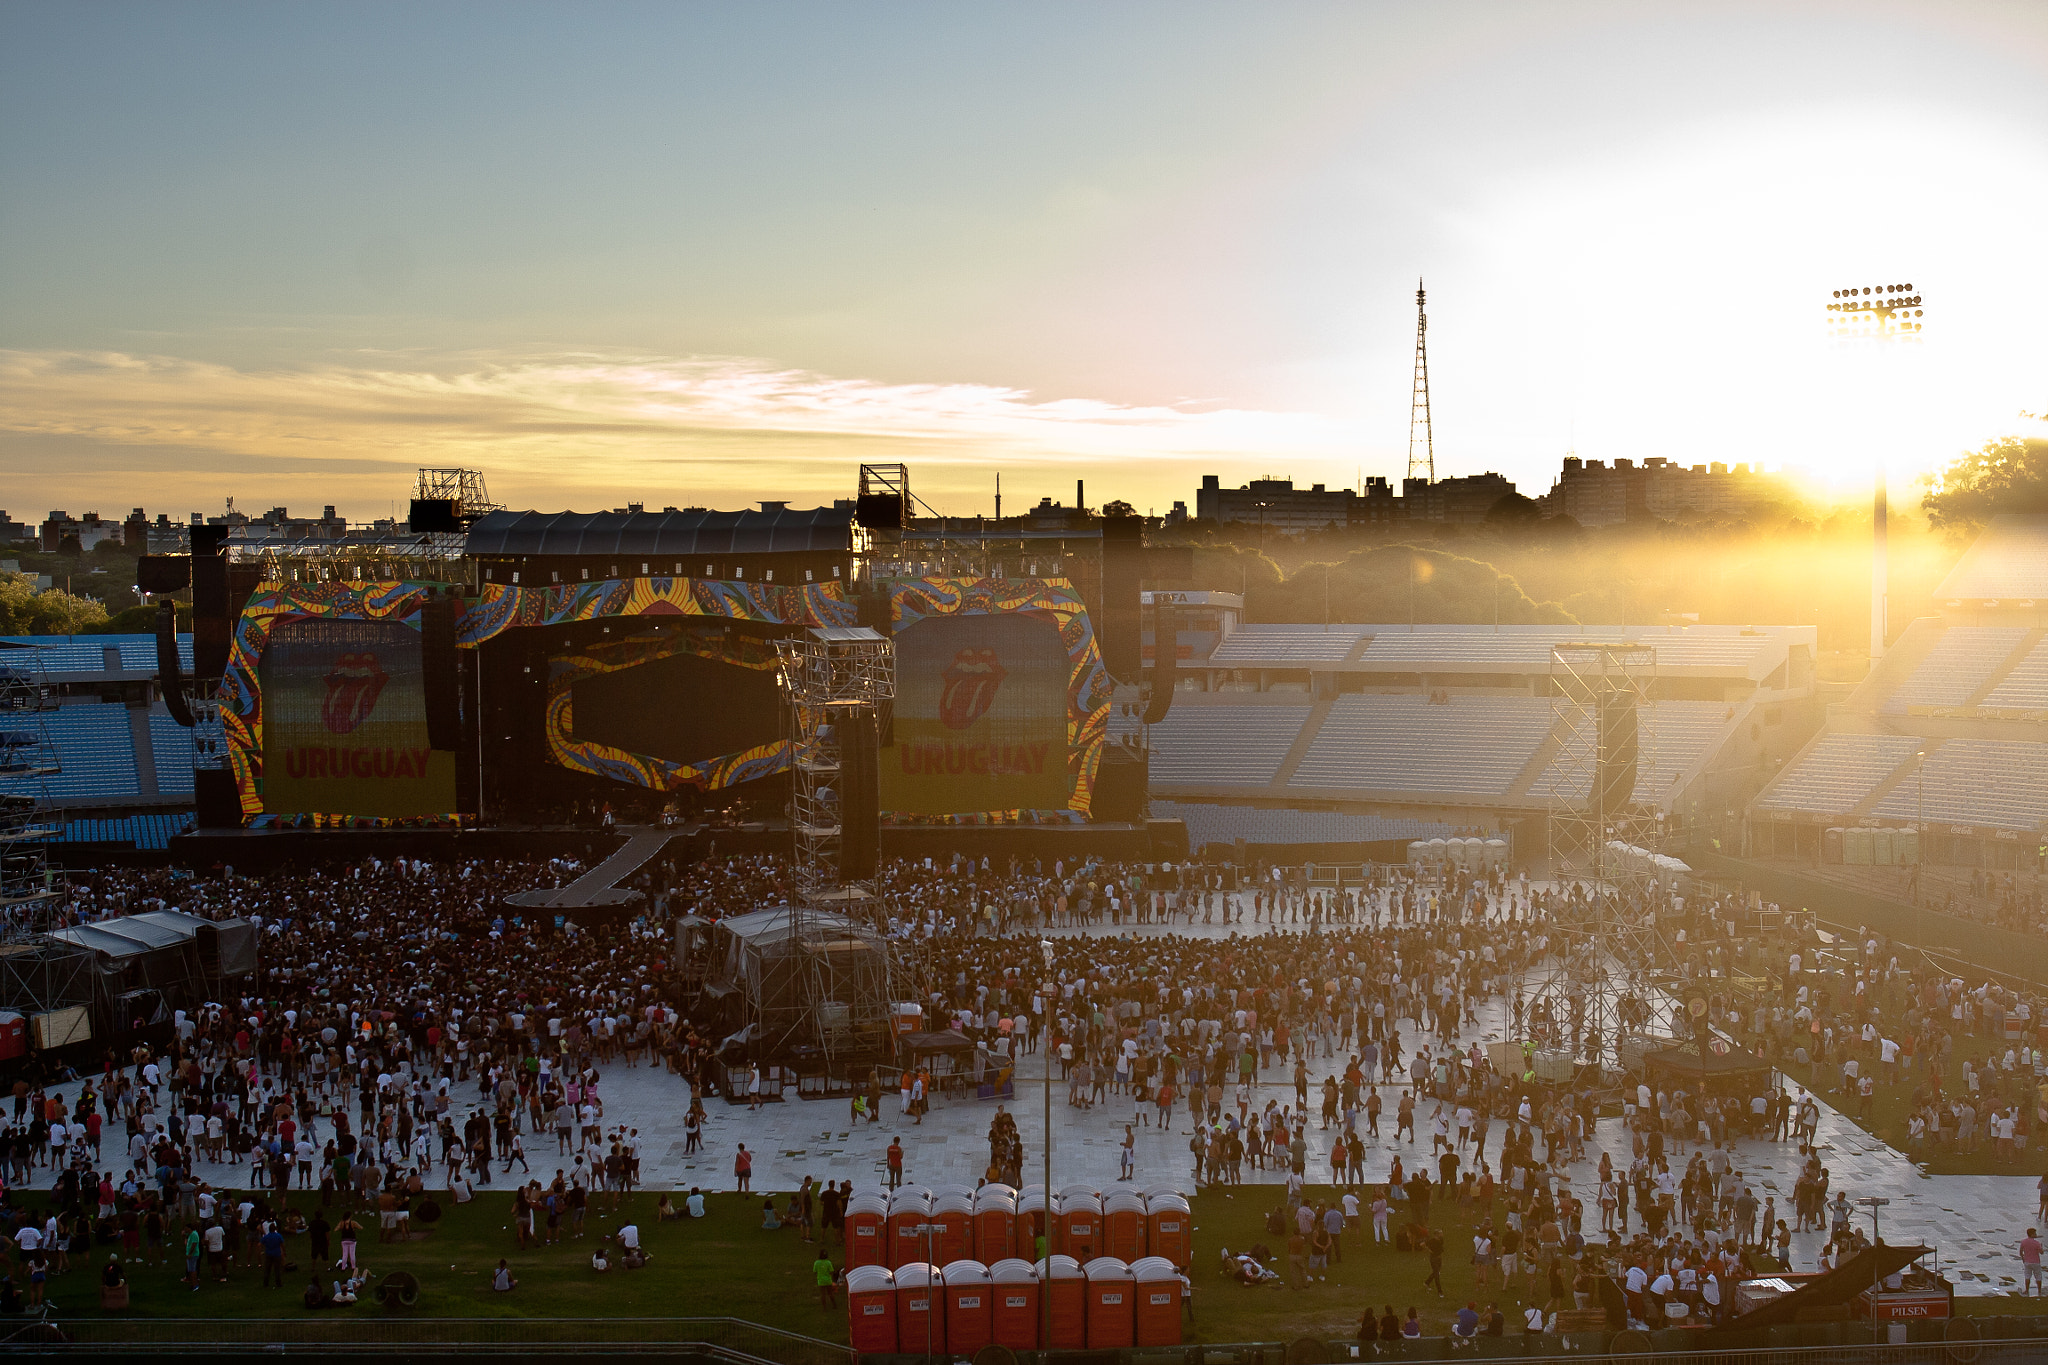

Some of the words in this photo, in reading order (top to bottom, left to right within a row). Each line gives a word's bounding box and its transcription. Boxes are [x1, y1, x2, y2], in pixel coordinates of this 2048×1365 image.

[286, 748, 431, 778] URUGUAY
[901, 744, 1050, 775] URUGUAY
[1891, 1306, 1928, 1317] PILSEN
